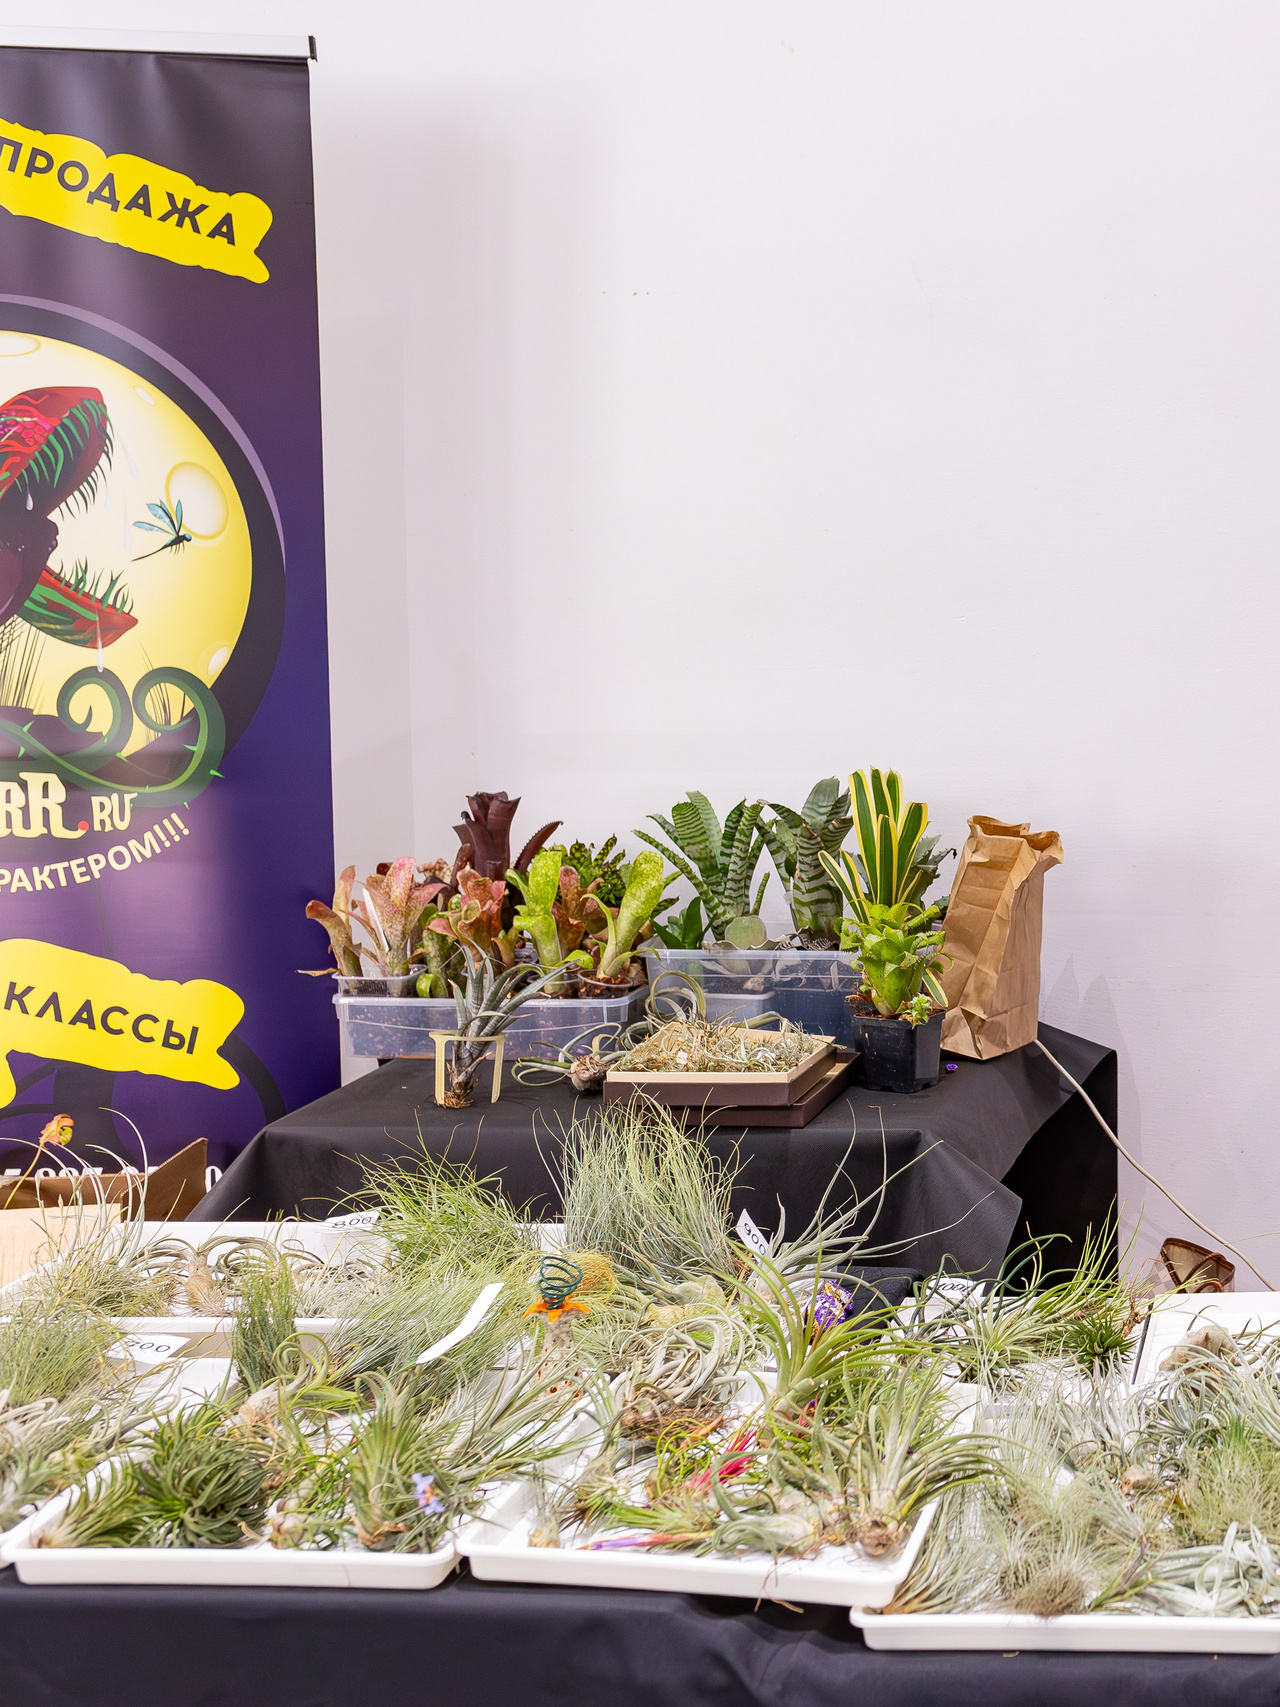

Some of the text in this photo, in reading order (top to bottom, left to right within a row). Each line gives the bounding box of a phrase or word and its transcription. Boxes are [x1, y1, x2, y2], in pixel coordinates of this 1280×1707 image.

[0, 136, 235, 247] ПРОДАЖА
[3, 981, 199, 1055] КЛАССЫ
[744, 1222, 766, 1255] 900
